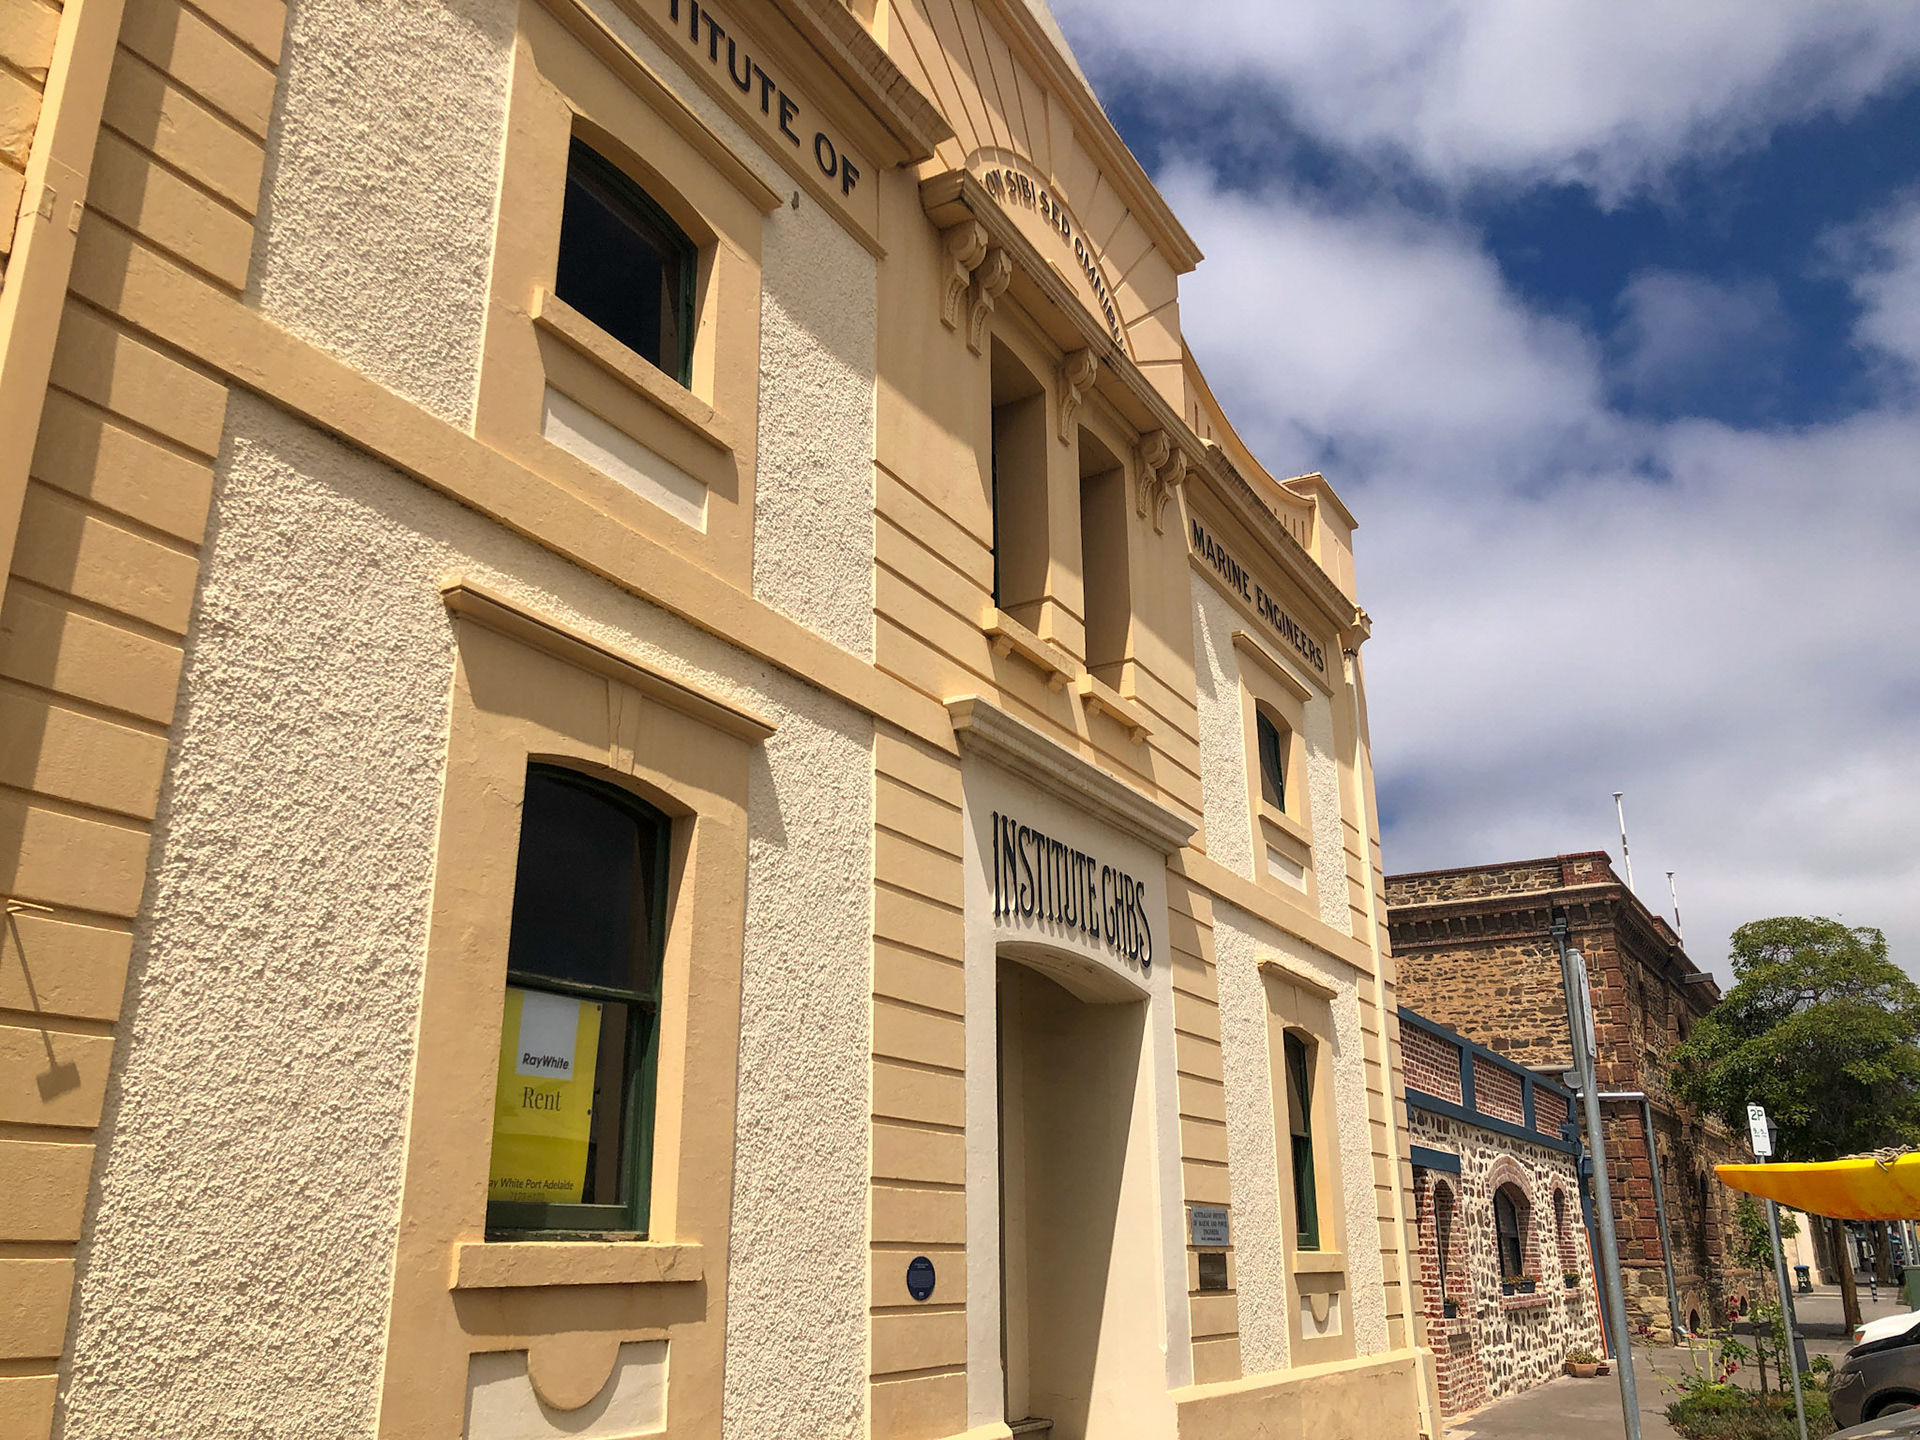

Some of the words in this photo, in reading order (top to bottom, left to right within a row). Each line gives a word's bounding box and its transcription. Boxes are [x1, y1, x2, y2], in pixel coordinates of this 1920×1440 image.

[814, 132, 860, 196] OF
[979, 168, 1005, 197] ON
[1005, 169, 1036, 204] SIBI
[1040, 190, 1070, 238] SED
[1192, 518, 1252, 601] MARINE
[1254, 584, 1324, 672] ENGINEERS
[993, 811, 1099, 938] INSTITUTE
[1102, 865, 1152, 968] GHBS
[522, 1053, 569, 1069] RayWhite
[522, 1086, 562, 1111] Rent
[1750, 1109, 1763, 1121] 2P
[500, 1178, 523, 1188] White
[525, 1179, 541, 1189] Port
[543, 1180, 574, 1190] Adelaide
